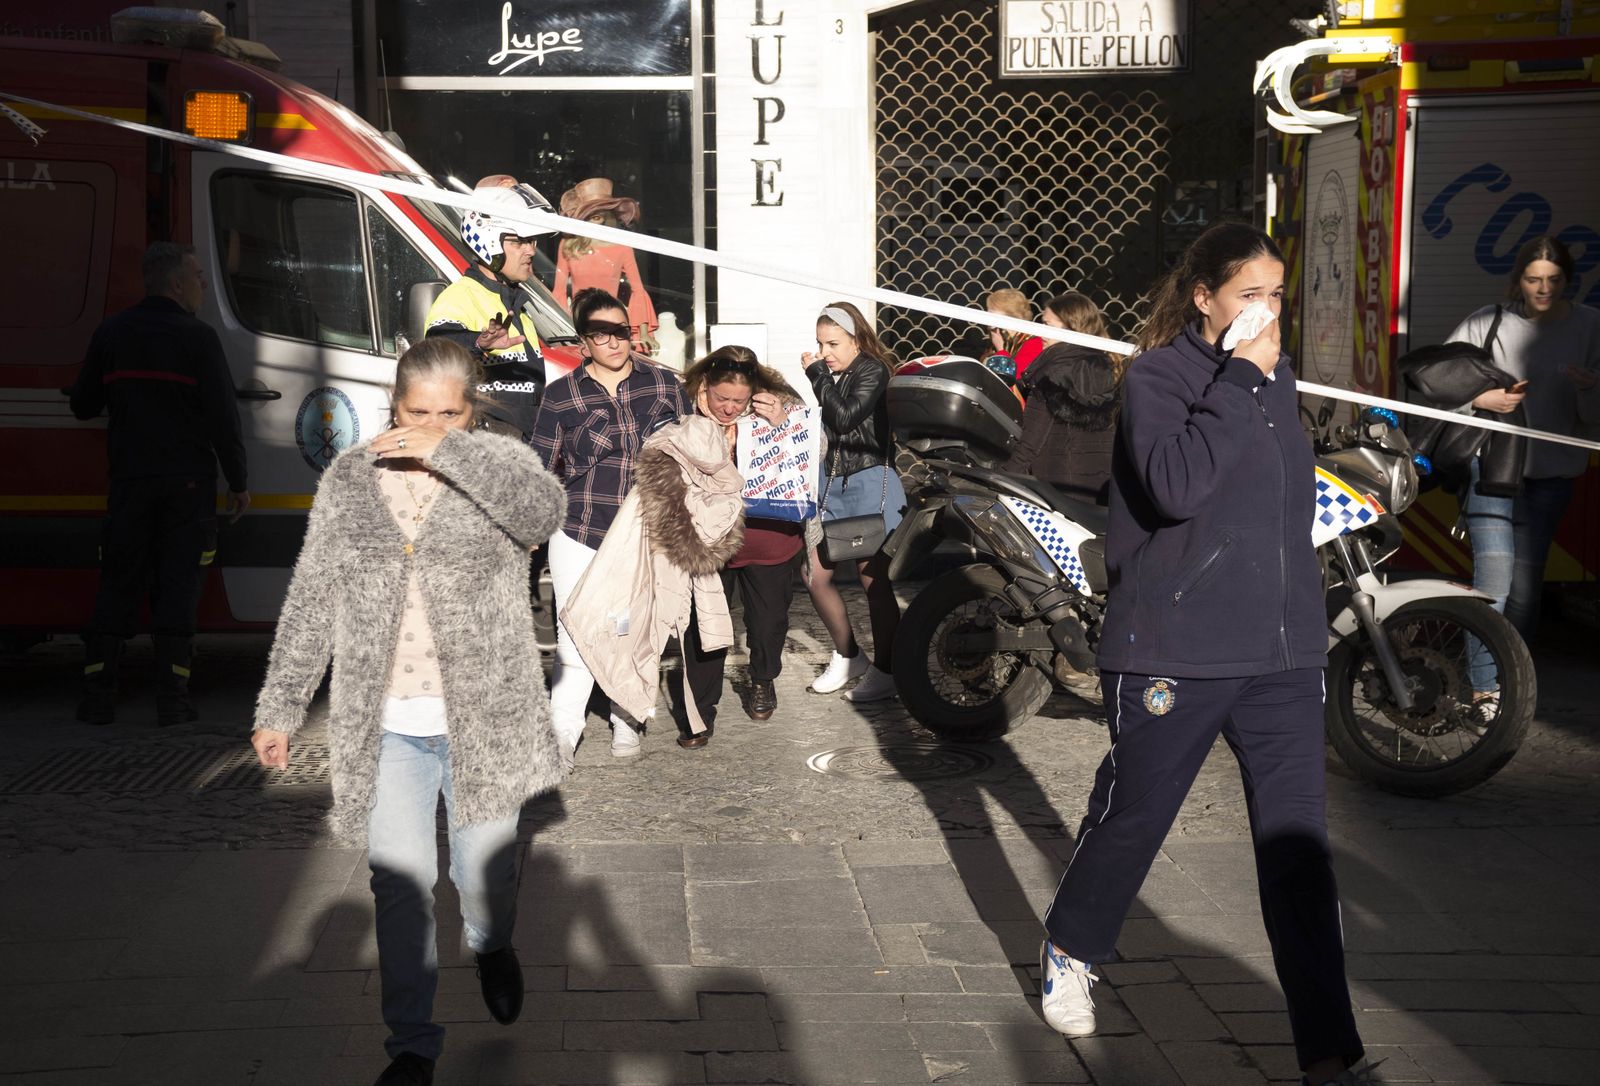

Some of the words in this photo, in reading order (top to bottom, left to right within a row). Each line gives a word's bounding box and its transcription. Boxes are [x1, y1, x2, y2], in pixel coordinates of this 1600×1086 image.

[33, 23, 112, 41] infanti
[835, 18, 844, 35] 3
[1040, 1, 1120, 33] SALIDA
[1139, 1, 1153, 32] A
[487, 1, 584, 75] Lupe
[1008, 36, 1091, 68] PUENTE
[1102, 34, 1187, 67] PELLON
[750, 0, 786, 207] LUPE
[0, 162, 56, 190] LA
[1364, 105, 1389, 394] BOMBERO
